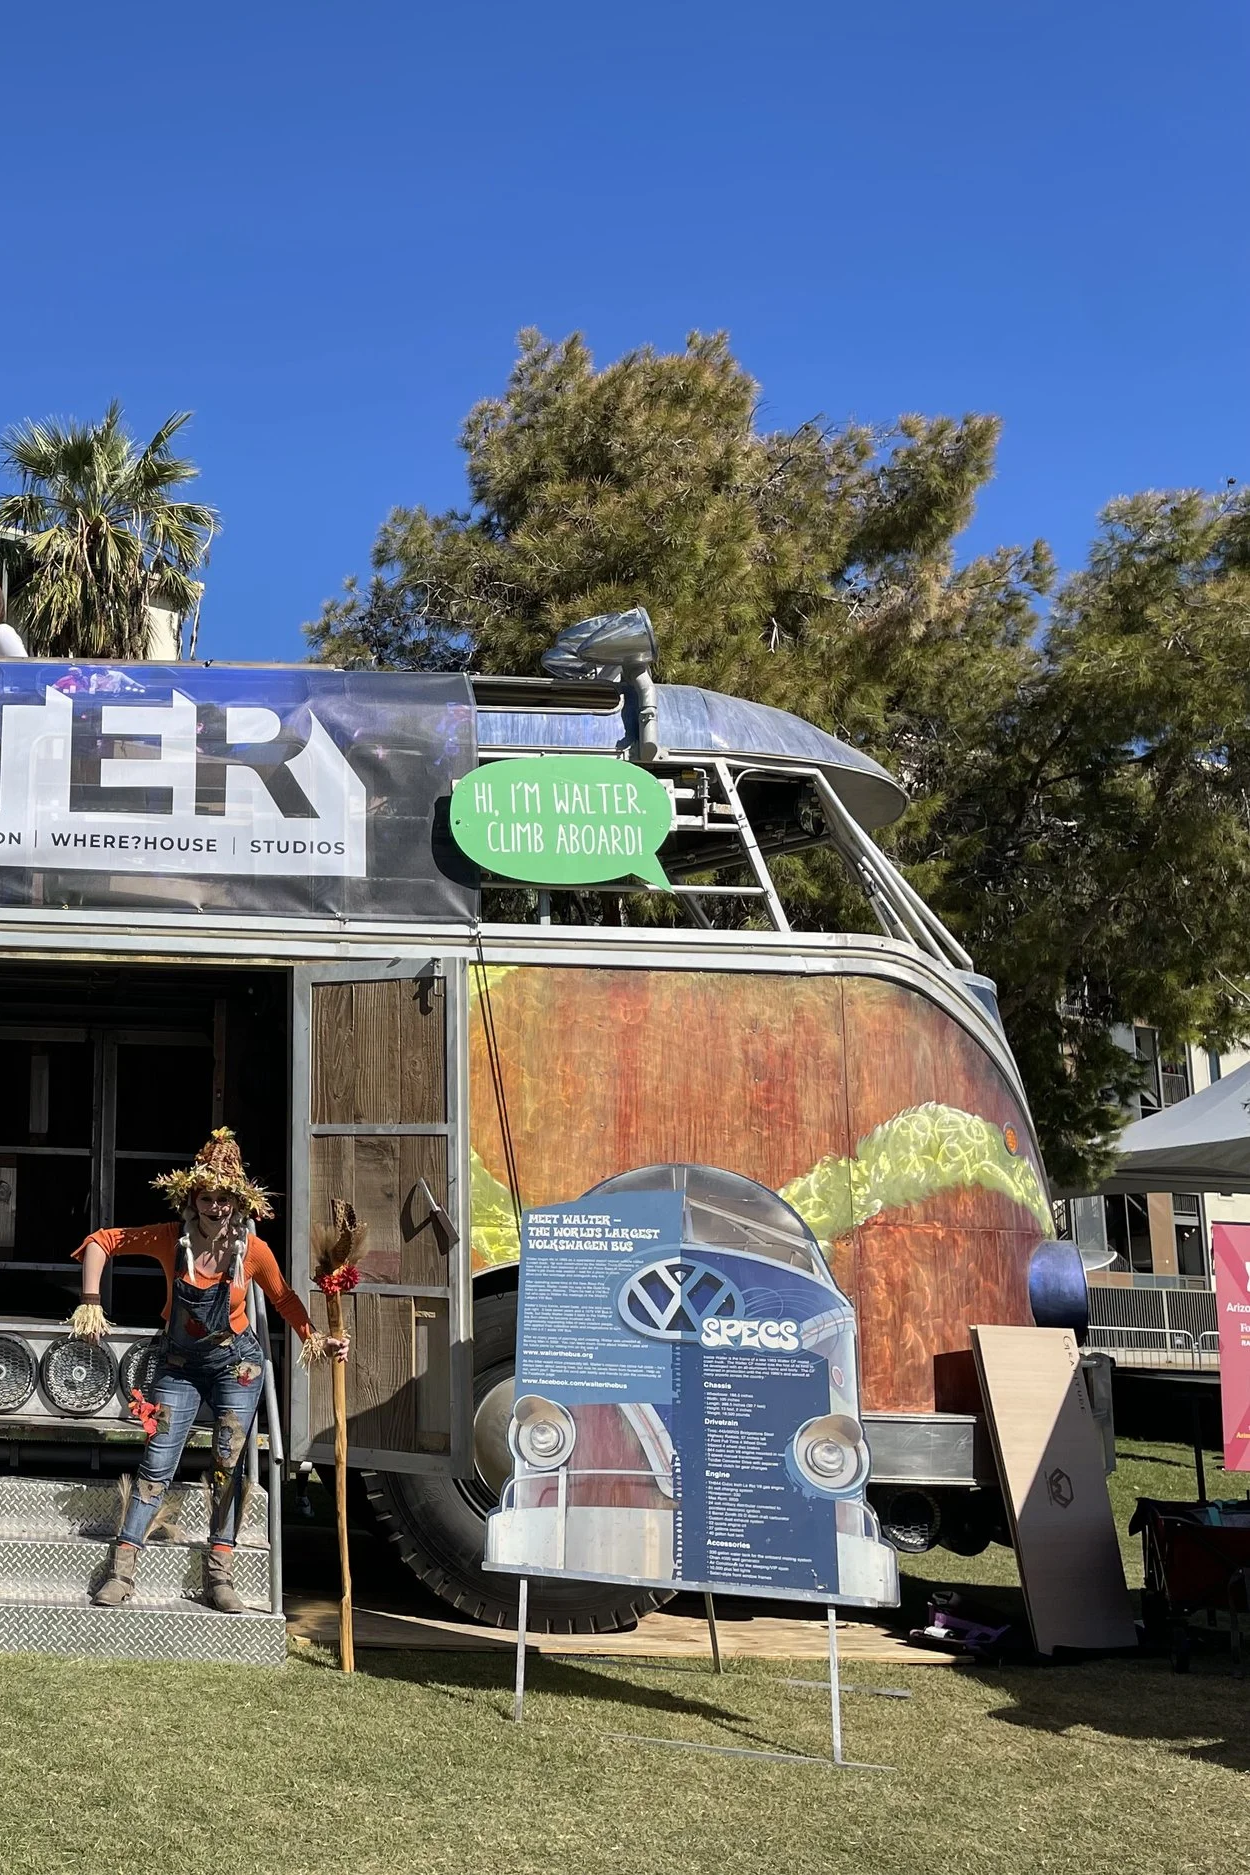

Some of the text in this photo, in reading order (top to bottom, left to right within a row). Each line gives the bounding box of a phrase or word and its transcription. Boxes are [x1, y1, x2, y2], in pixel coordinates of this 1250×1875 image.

[474, 781, 647, 817] HI, I'M WALTER.
[51, 832, 218, 852] WHERE?HOUSE
[250, 840, 346, 855] STUDIOS
[487, 821, 644, 856] CLIMB ABOARD!
[528, 1214, 559, 1224] MEET
[562, 1214, 611, 1226] WALTER
[528, 1227, 550, 1237] THE
[604, 1228, 660, 1240] LARGEST
[528, 1239, 633, 1252] VOLKSWAGEN BUS
[701, 1317, 799, 1351] SPECS
[522, 1349, 593, 1359] www.walterthebus.org
[522, 1378, 627, 1389] www.facebook.com/walterthebus
[704, 1381, 731, 1389] Chassis
[704, 1418, 738, 1426] Drivetrain
[705, 1470, 730, 1478] Engine
[706, 1539, 750, 1549] Accessories
